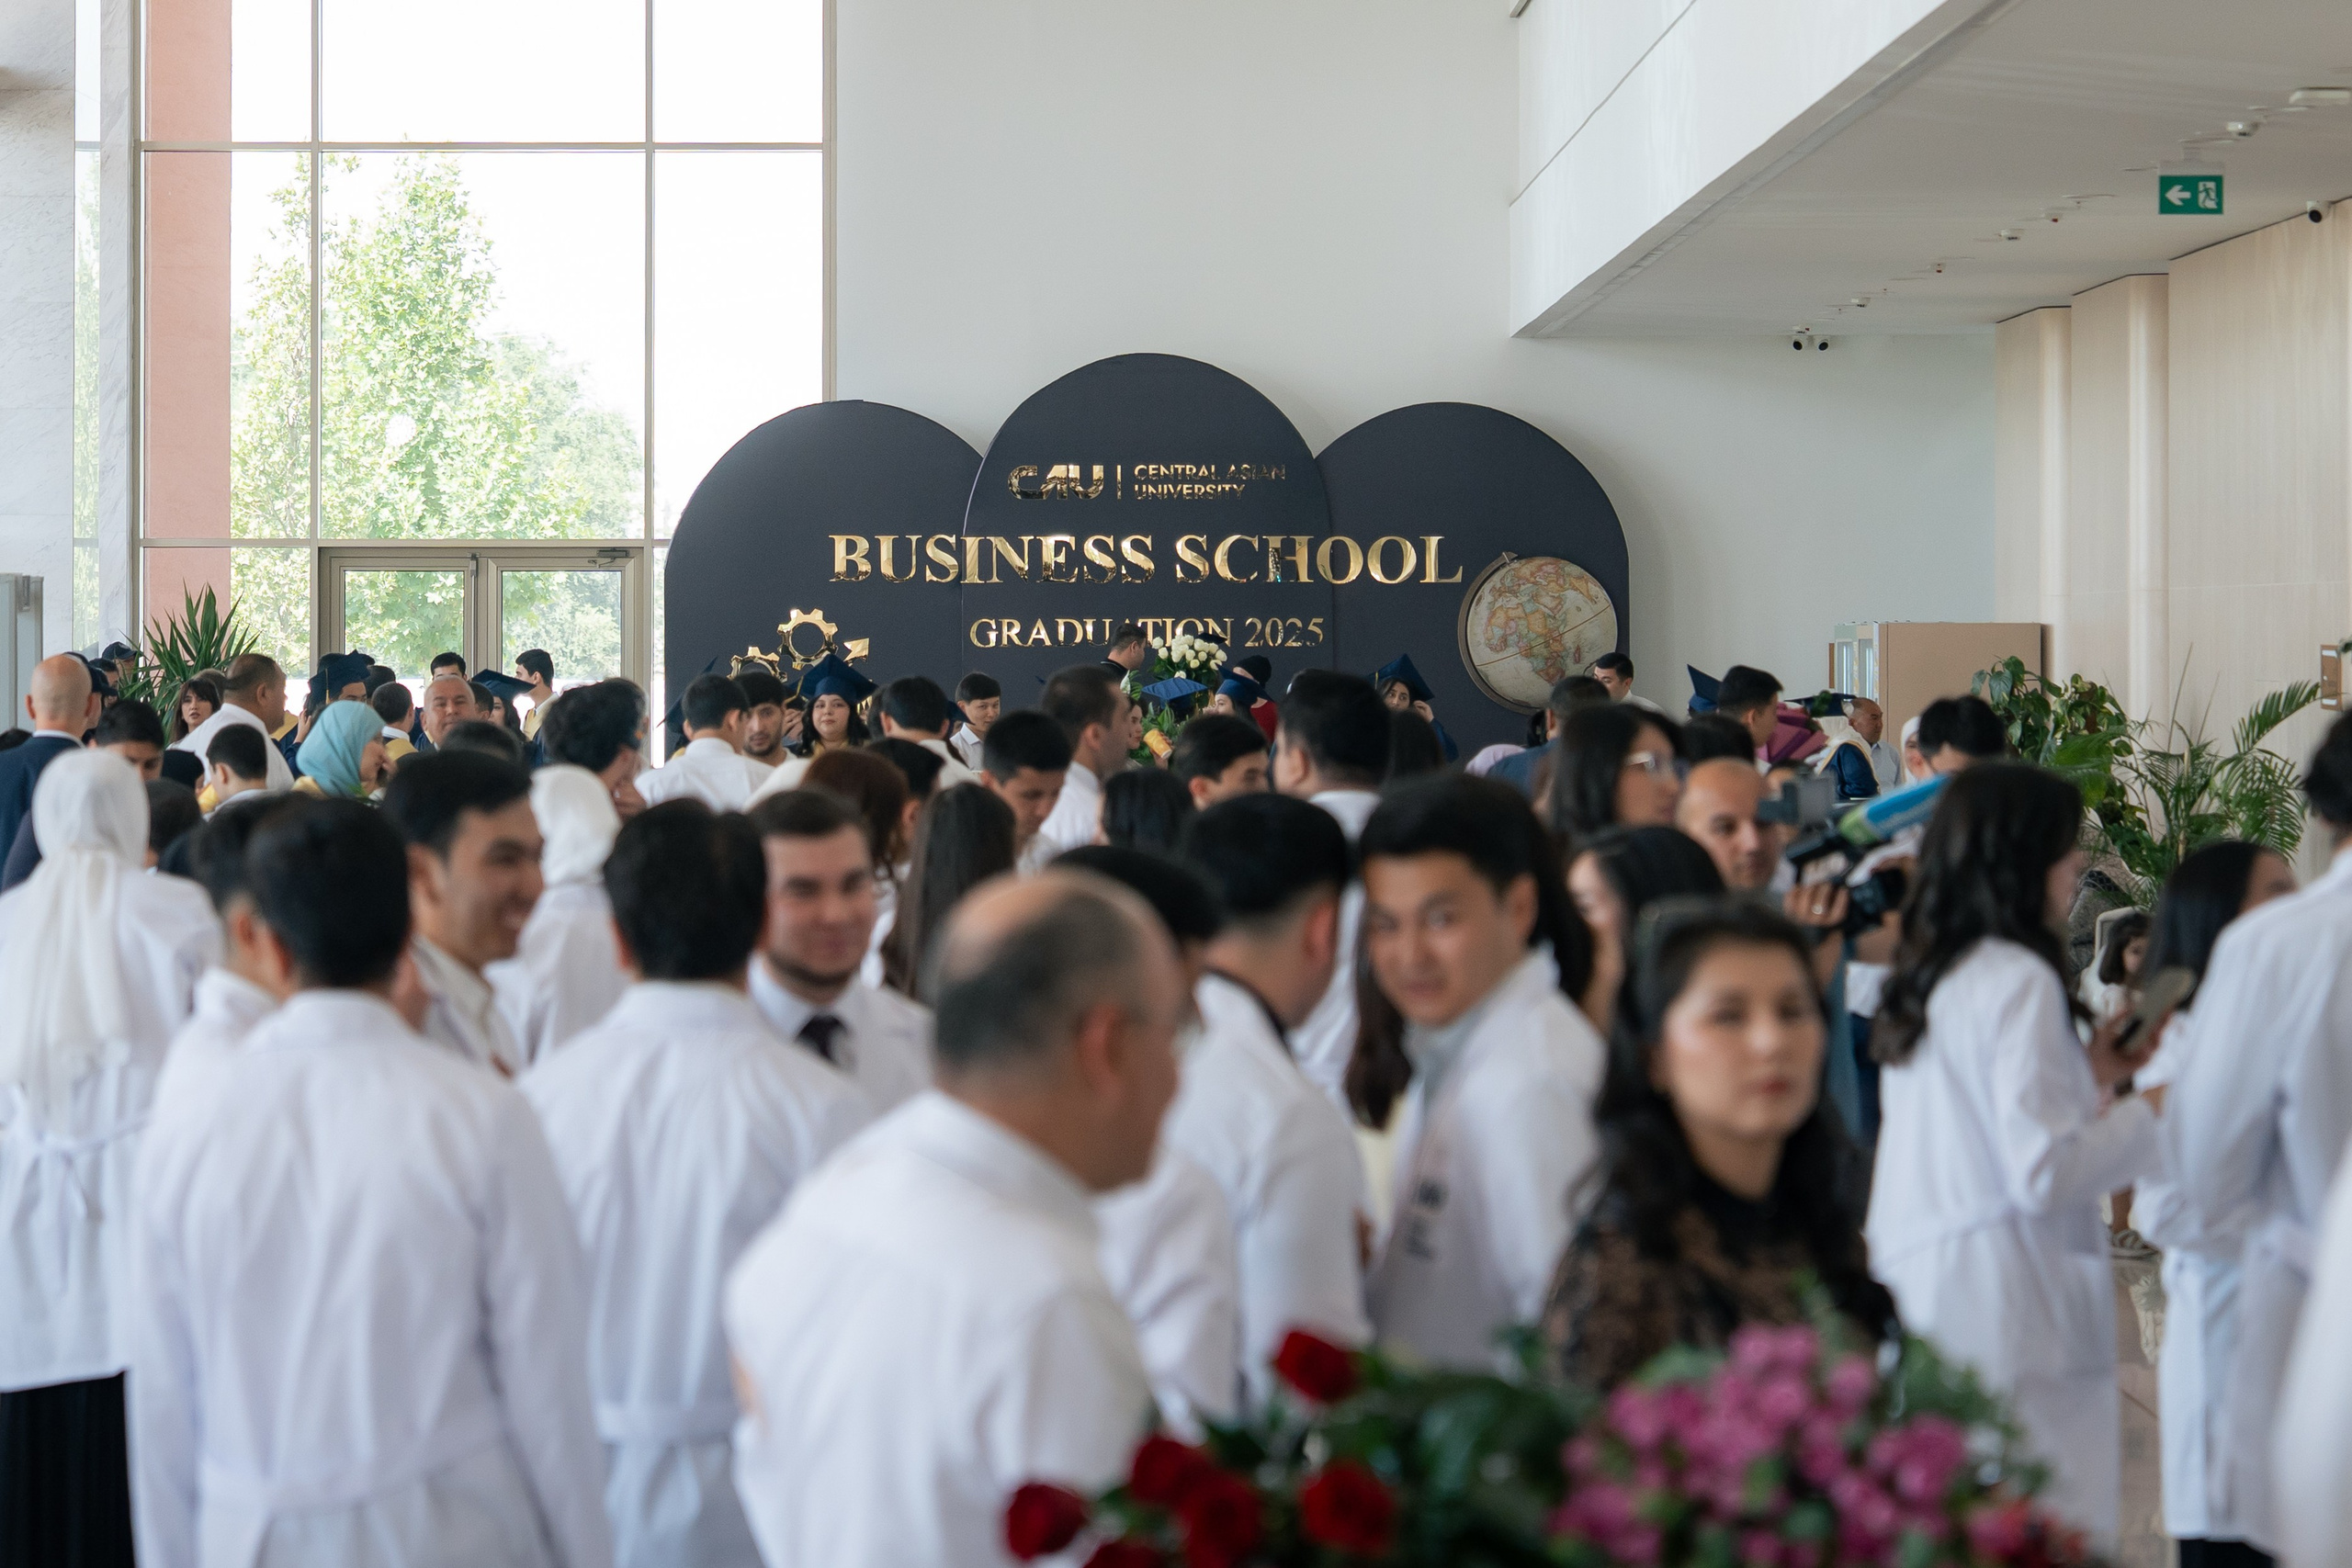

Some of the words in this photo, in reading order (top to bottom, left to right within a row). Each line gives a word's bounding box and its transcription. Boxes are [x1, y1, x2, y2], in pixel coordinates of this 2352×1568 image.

[1007, 465, 1104, 501] CAU
[1134, 464, 1222, 481] CENTRAL
[1226, 464, 1286, 480] ASIAN
[1134, 483, 1247, 501] UNIVERSITY
[828, 534, 1156, 584] BUSINESS
[1174, 534, 1464, 585] SCHOOL
[969, 617, 1235, 648] GRADUTION
[1244, 617, 1325, 648] 2025
